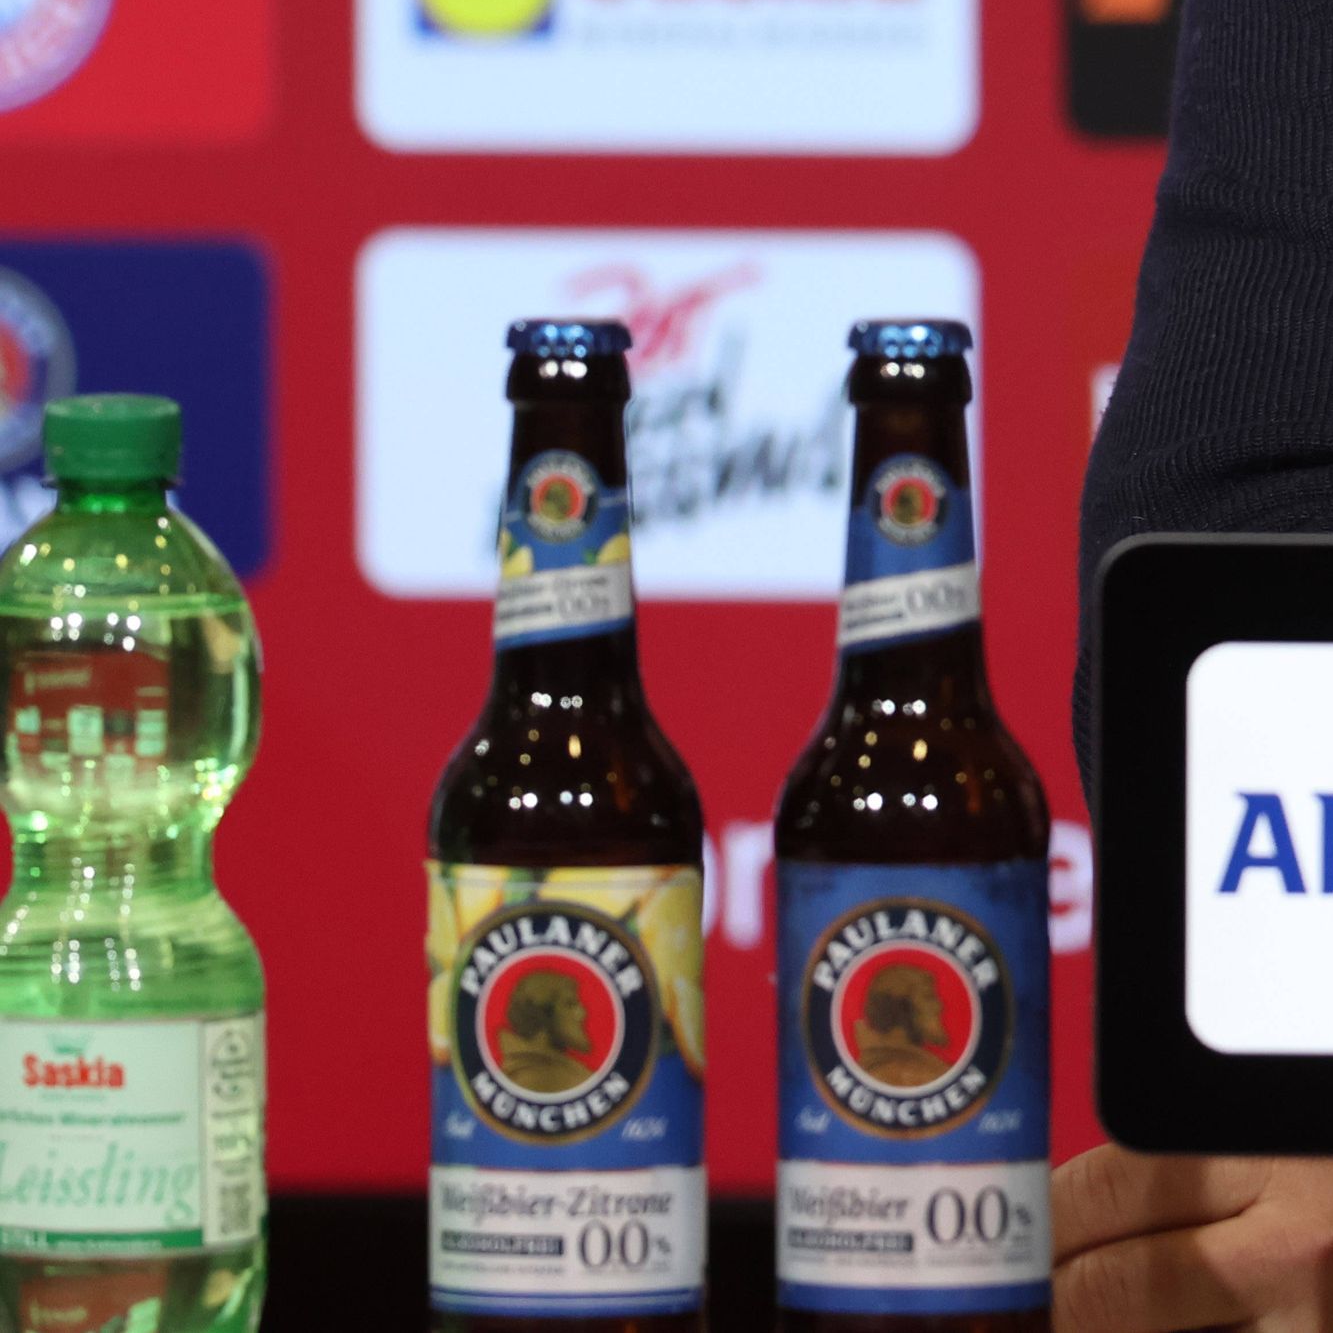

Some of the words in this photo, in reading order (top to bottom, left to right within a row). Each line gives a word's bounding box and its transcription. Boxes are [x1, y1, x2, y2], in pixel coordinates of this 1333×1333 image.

[460, 915, 644, 998] PAULANER
[813, 909, 999, 992] PAULANER
[23, 1053, 126, 1089] Saskia
[471, 1068, 631, 1133] MÜNCHEN
[826, 1063, 987, 1126] MÜNCHEN
